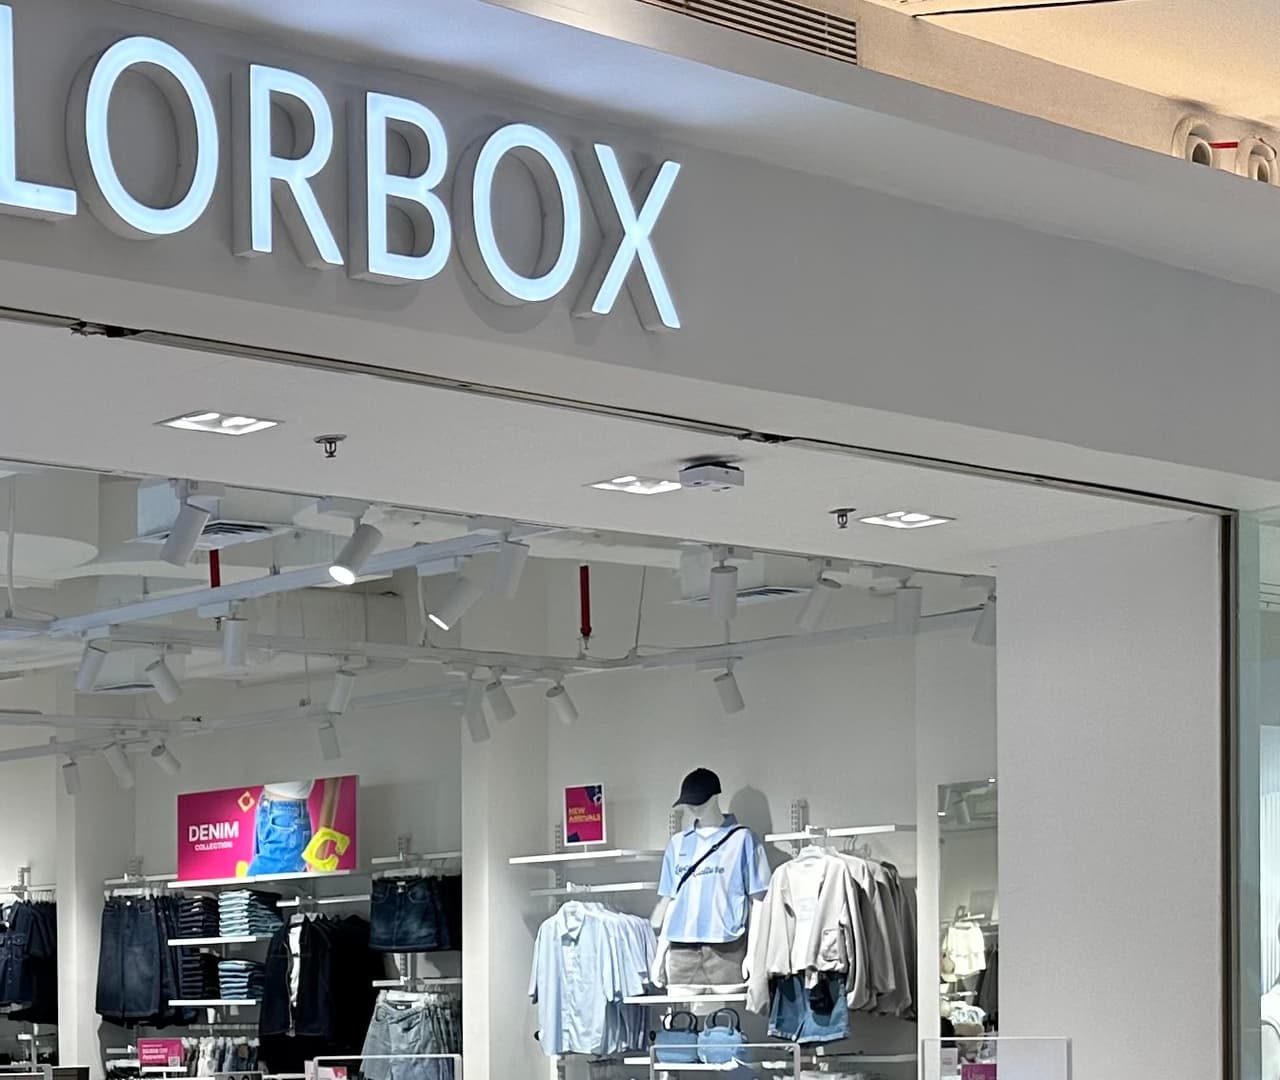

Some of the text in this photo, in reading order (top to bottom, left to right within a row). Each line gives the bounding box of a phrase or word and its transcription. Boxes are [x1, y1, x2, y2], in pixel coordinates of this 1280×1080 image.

[568, 807, 585, 815] NEW
[189, 821, 240, 842] DENIM
[195, 841, 233, 852] COLLECTION
